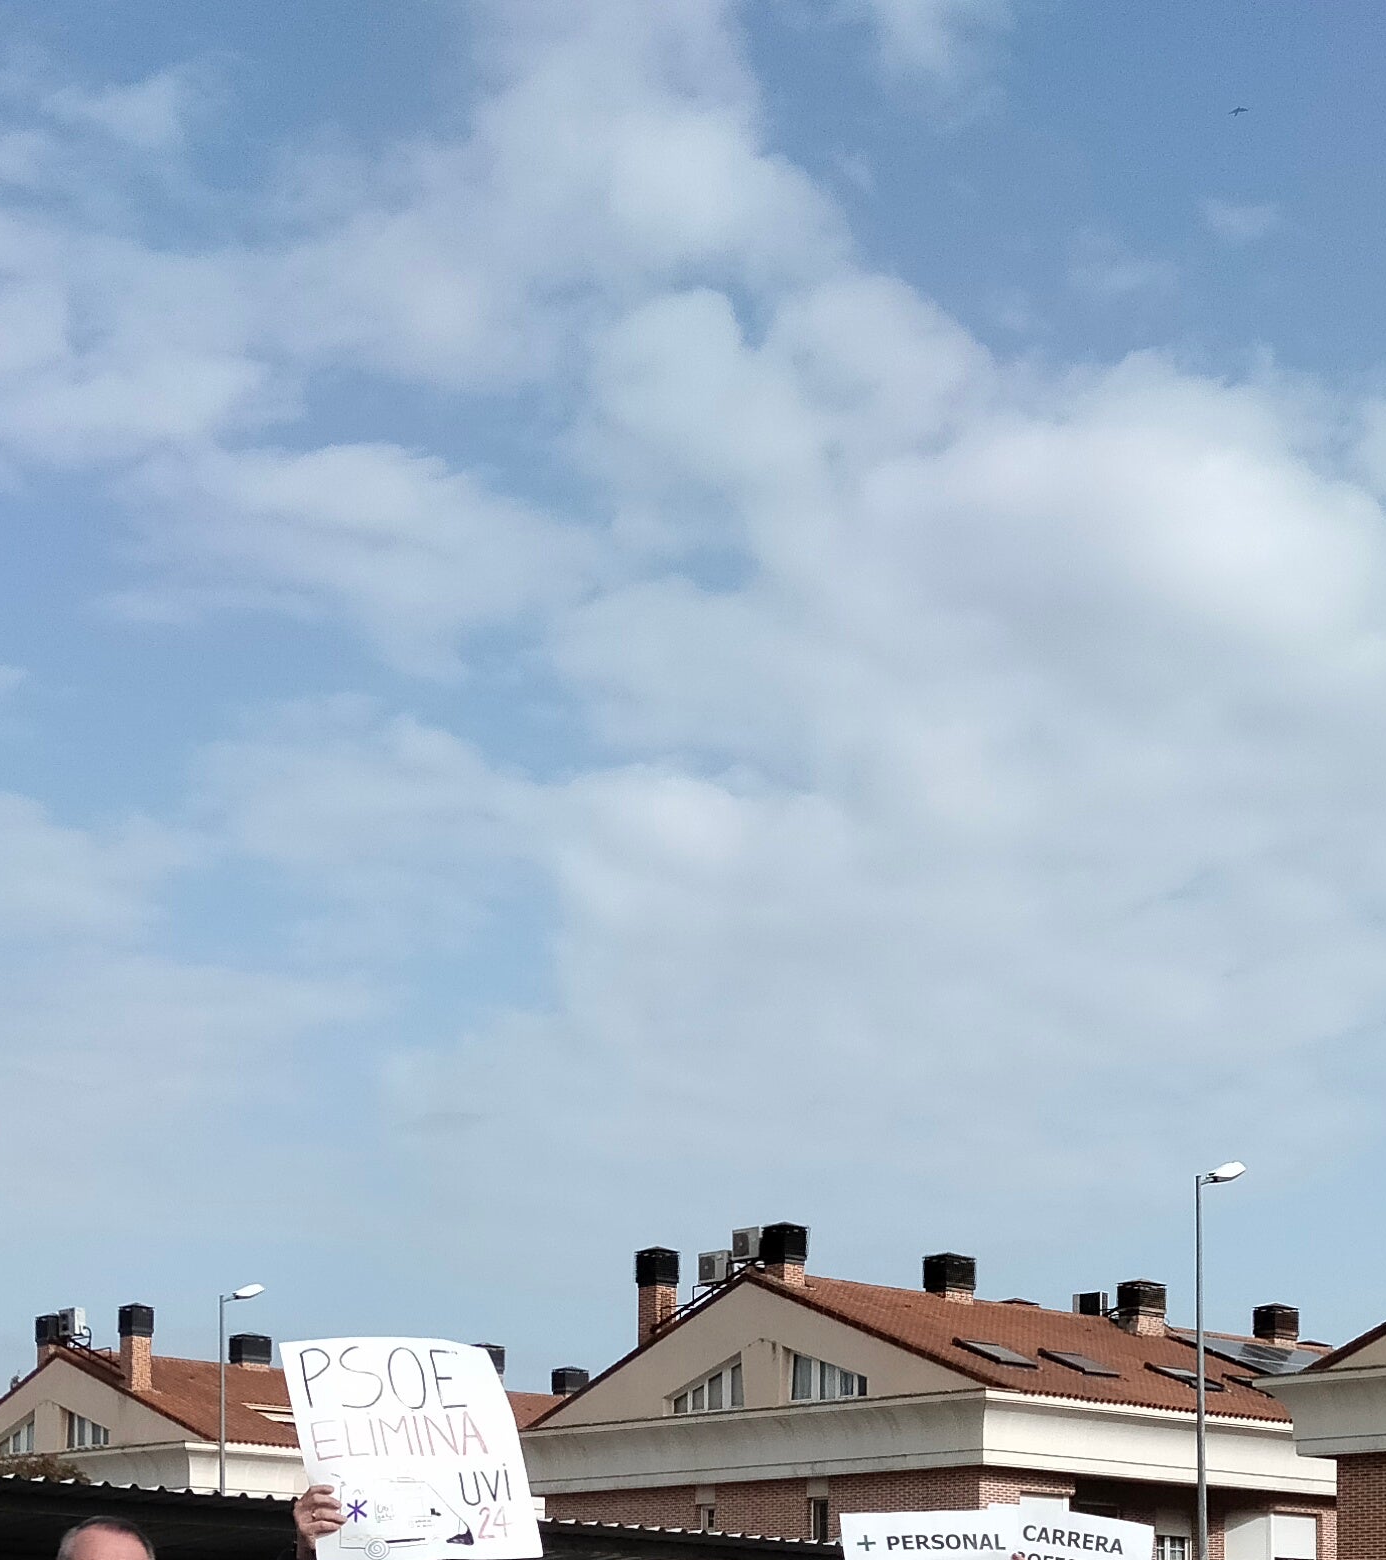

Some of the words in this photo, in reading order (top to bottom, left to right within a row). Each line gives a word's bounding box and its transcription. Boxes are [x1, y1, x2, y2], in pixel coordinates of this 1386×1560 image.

[299, 1346, 467, 1409] PSOE
[477, 1506, 513, 1539] 24
[886, 1533, 1006, 1550] PERSONAL
[1022, 1524, 1124, 1555] CARRERA
